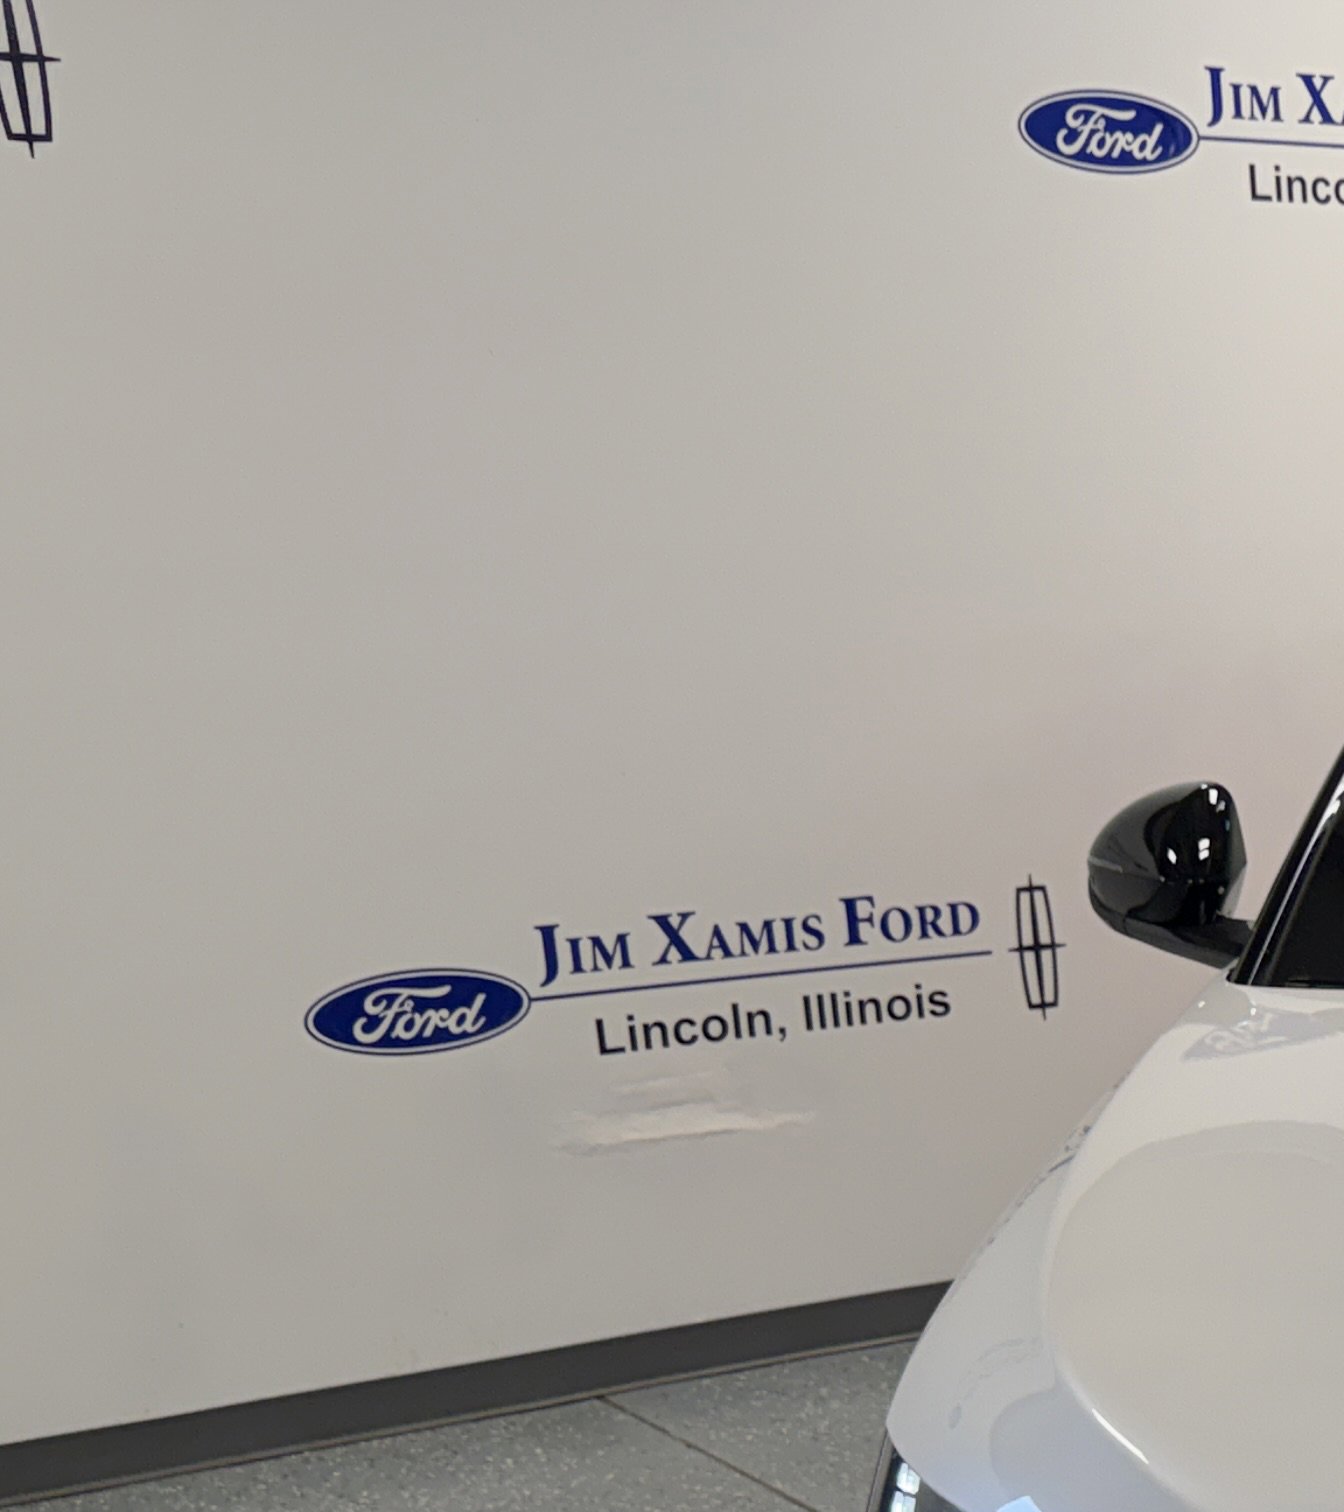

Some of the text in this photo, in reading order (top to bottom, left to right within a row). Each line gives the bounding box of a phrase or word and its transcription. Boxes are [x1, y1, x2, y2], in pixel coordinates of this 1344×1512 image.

[1057, 103, 1162, 162] Ford
[352, 985, 486, 1044] Ford
[595, 983, 952, 1057] Lincoln, Illinois
